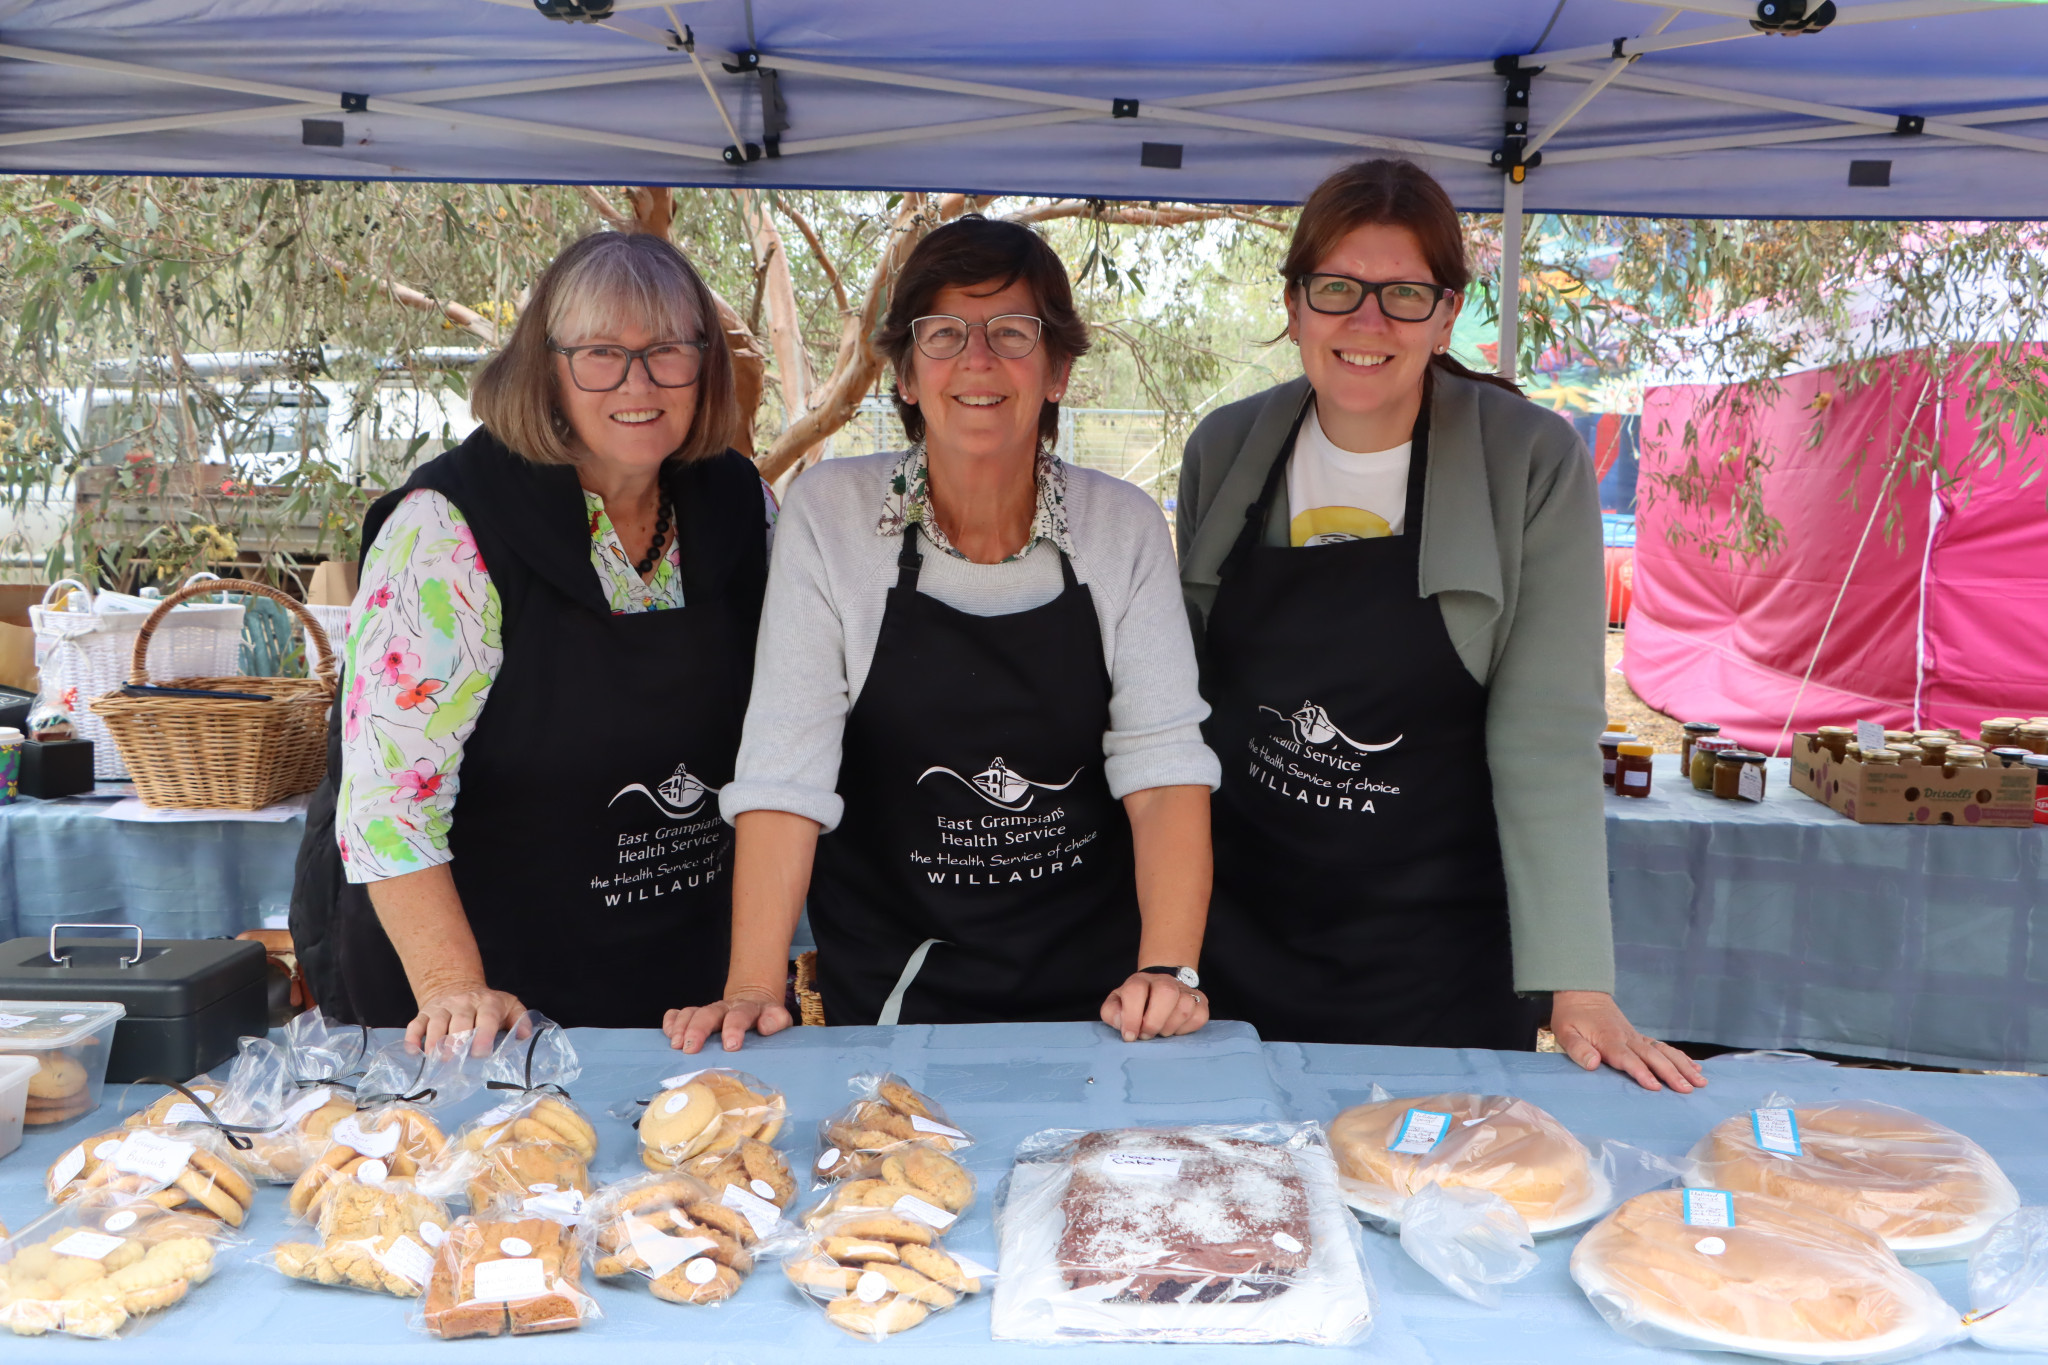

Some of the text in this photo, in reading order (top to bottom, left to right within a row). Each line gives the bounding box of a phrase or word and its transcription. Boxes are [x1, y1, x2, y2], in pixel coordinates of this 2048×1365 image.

[1249, 737, 1400, 795] the Health Service of choice
[1268, 735, 1300, 755] ealth
[1303, 745, 1361, 772] Service
[1249, 762, 1376, 814] WILLAURA
[617, 816, 722, 847] East Grampians
[937, 807, 1065, 831] East Grampians
[618, 845, 665, 864] Health
[671, 832, 720, 853] Service
[910, 831, 1097, 867] the Health Service of choice
[941, 825, 1066, 847] Health Service
[590, 876, 610, 889] the
[614, 867, 653, 887] Health
[656, 861, 700, 877] Service
[927, 855, 1083, 885] WILLAURA
